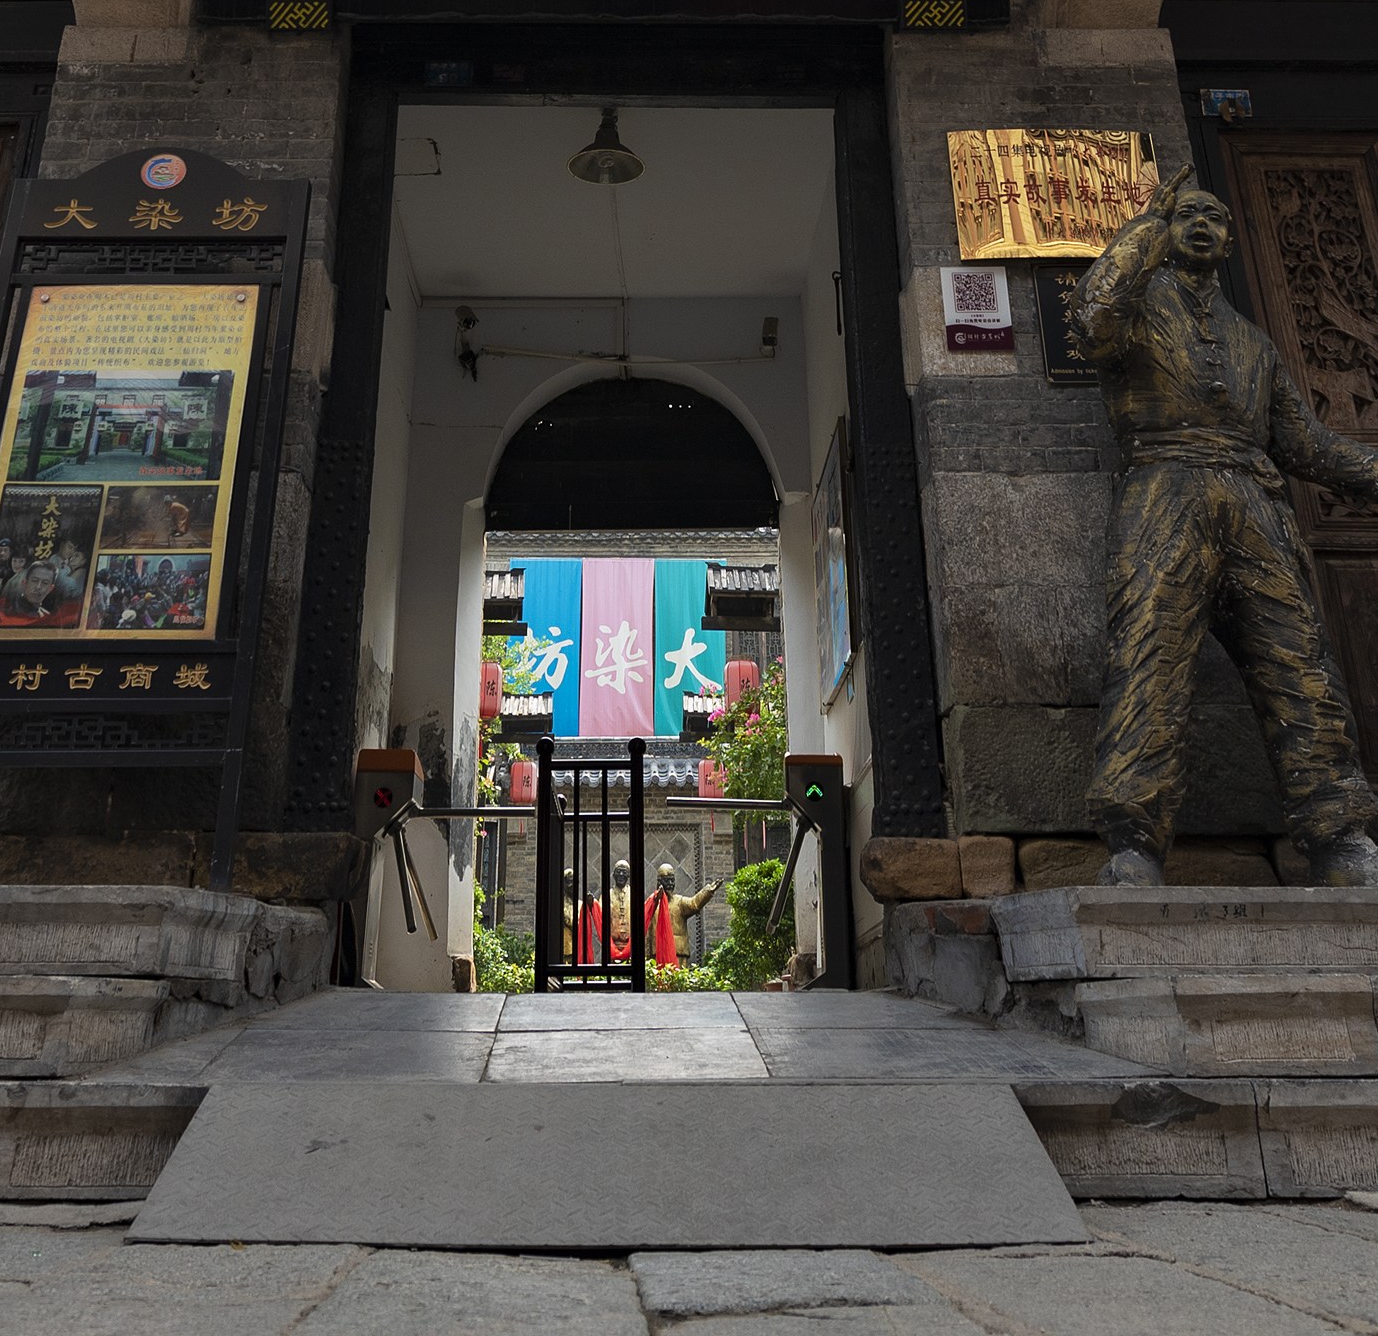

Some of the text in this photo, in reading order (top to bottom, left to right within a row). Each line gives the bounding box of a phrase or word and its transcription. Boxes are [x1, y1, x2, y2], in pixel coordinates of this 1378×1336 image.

[974, 178, 1148, 208] 真实故事发生地
[43, 197, 269, 233] 大染坊
[34, 496, 62, 560] 大染坊
[515, 620, 722, 694] 大染坊
[486, 680, 497, 697] 陈
